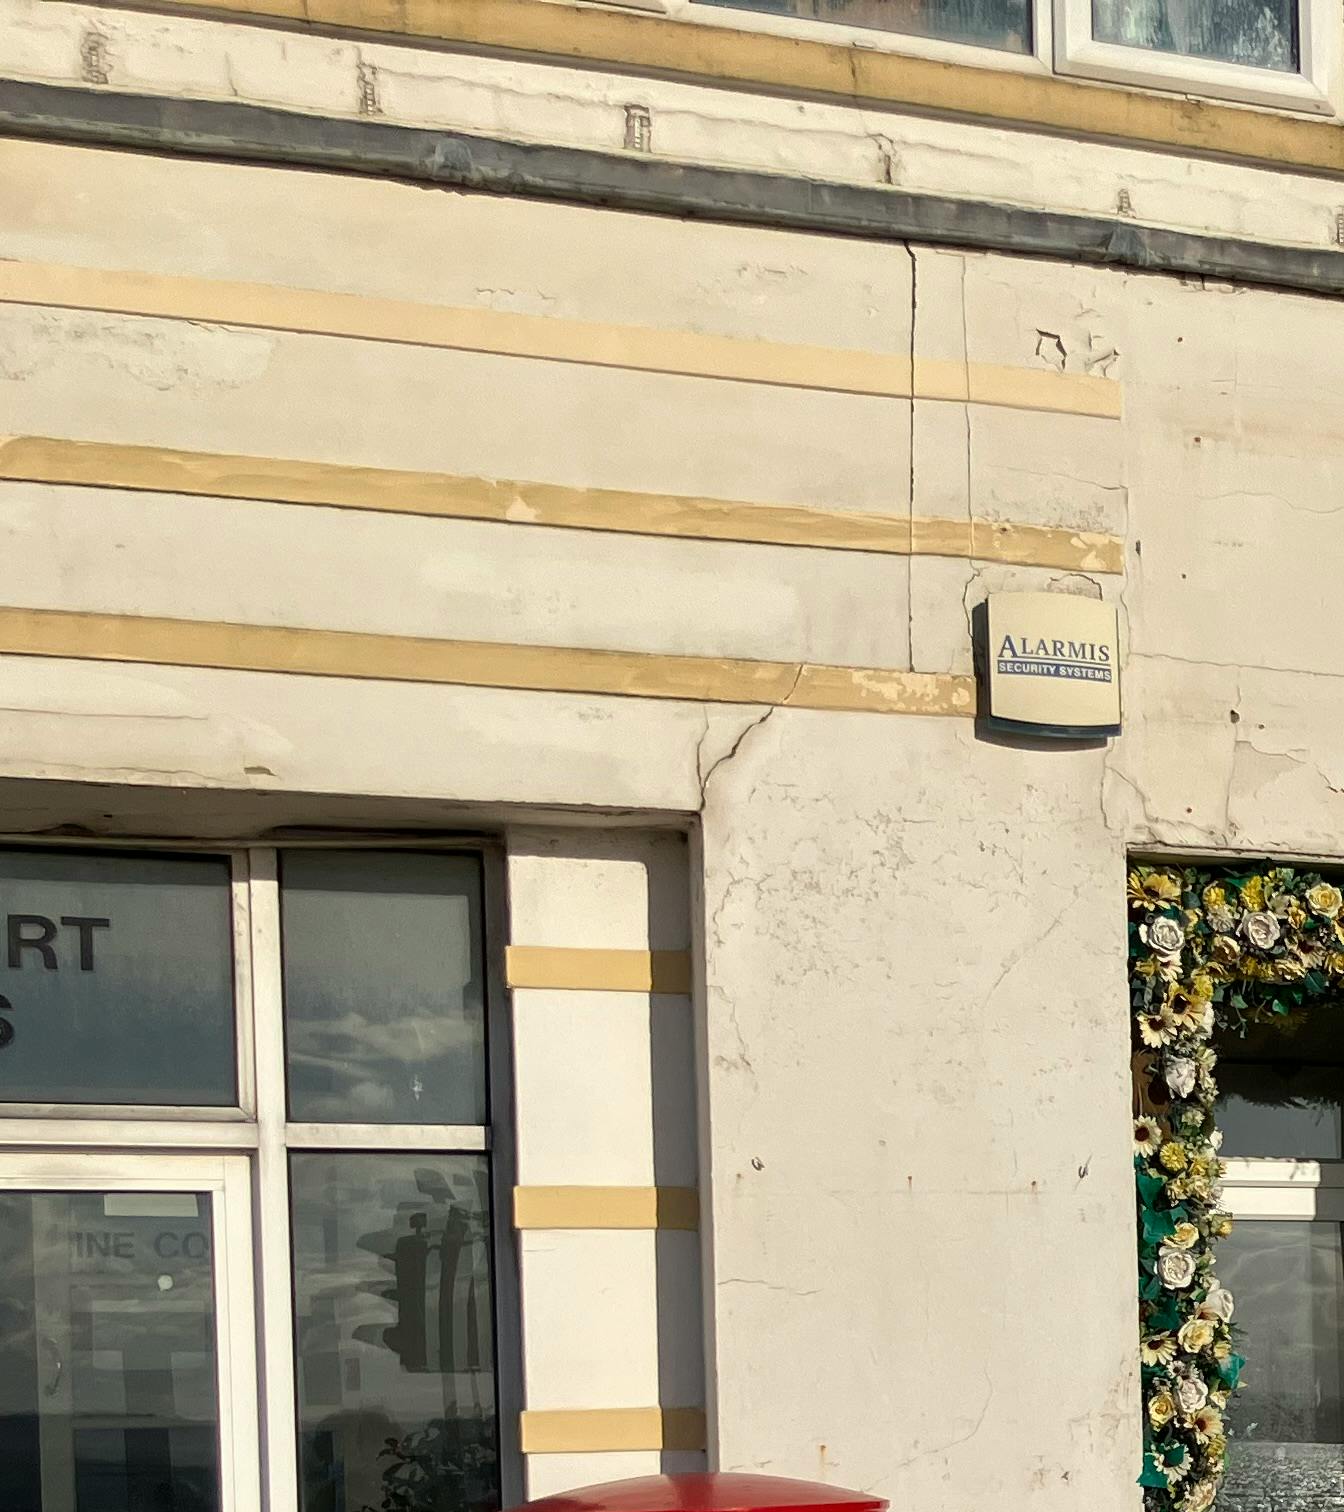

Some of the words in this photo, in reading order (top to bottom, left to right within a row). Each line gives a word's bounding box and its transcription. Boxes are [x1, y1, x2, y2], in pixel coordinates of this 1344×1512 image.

[998, 634, 1110, 662] ALARMIS
[998, 661, 1056, 675] SECURITY
[1059, 665, 1112, 681] SYSTEMS
